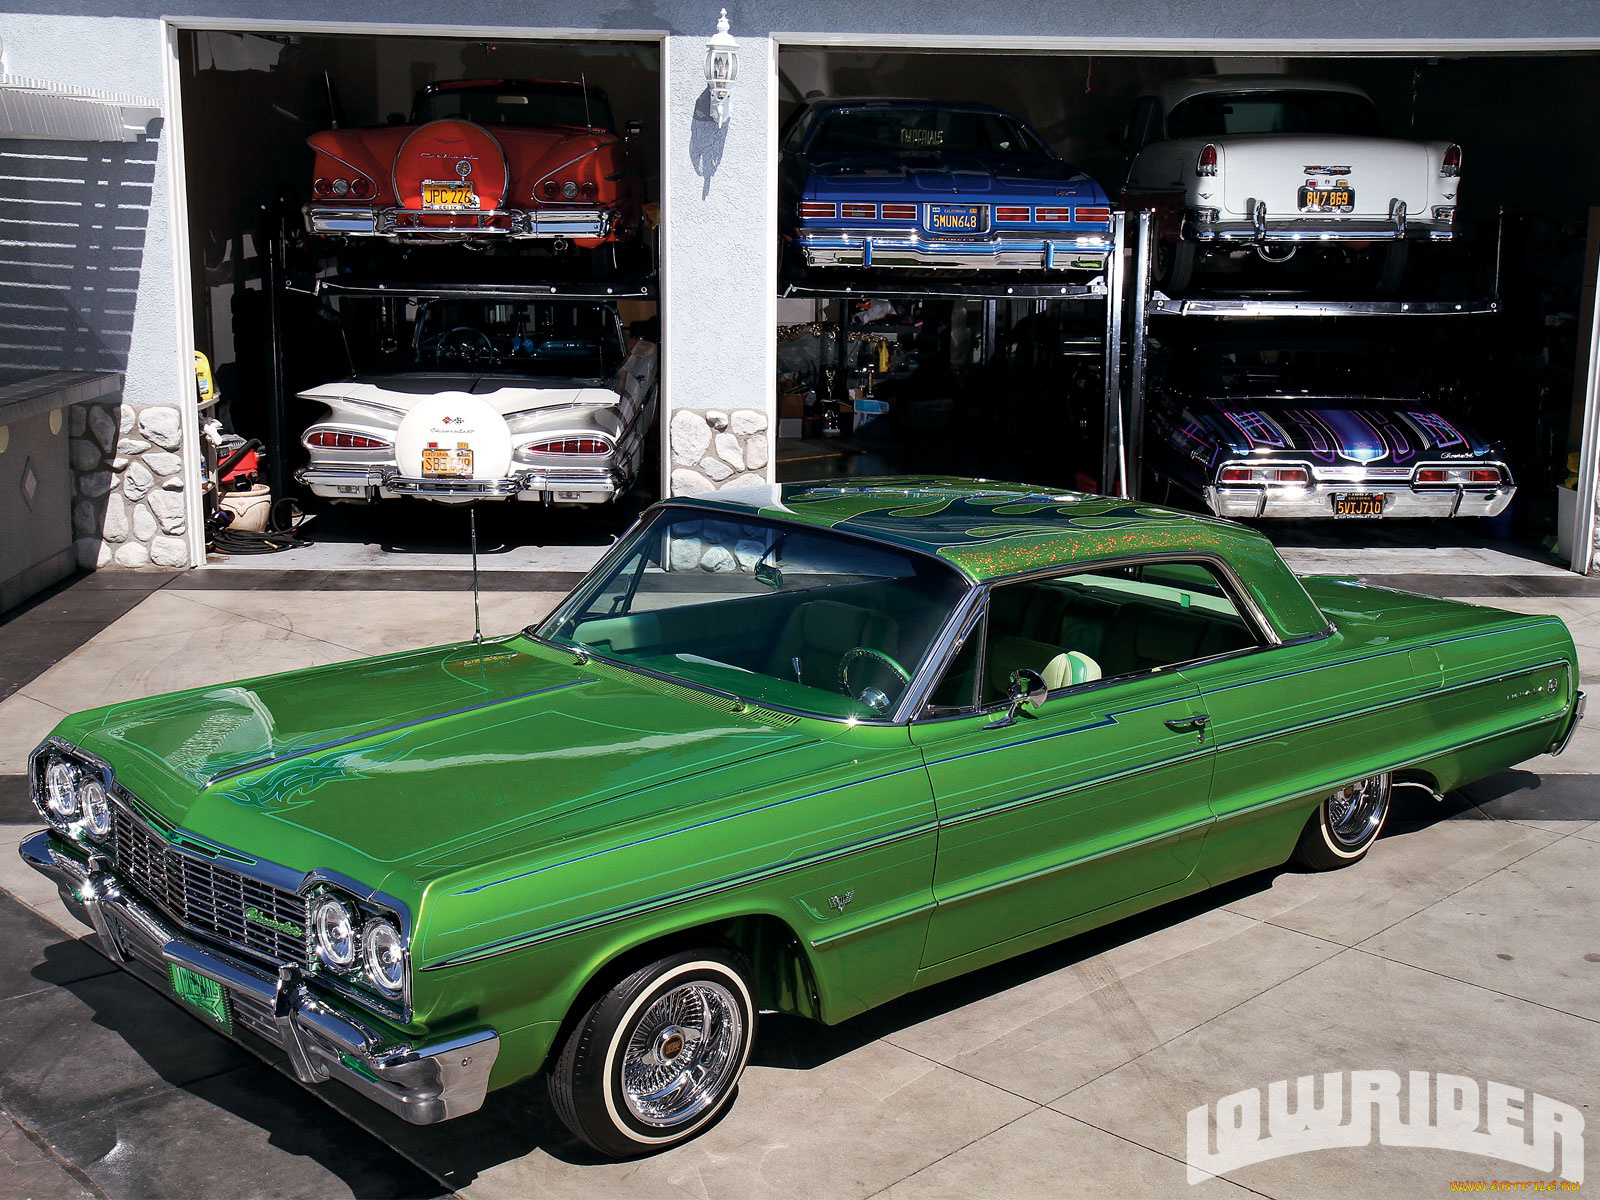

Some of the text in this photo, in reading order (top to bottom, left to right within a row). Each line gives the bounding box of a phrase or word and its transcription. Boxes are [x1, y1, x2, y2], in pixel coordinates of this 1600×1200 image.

[425, 190, 471, 203] JPC 226
[1329, 192, 1348, 205] 869
[933, 215, 977, 228] 5MUN648
[1338, 501, 1381, 514] 5VIJ710
